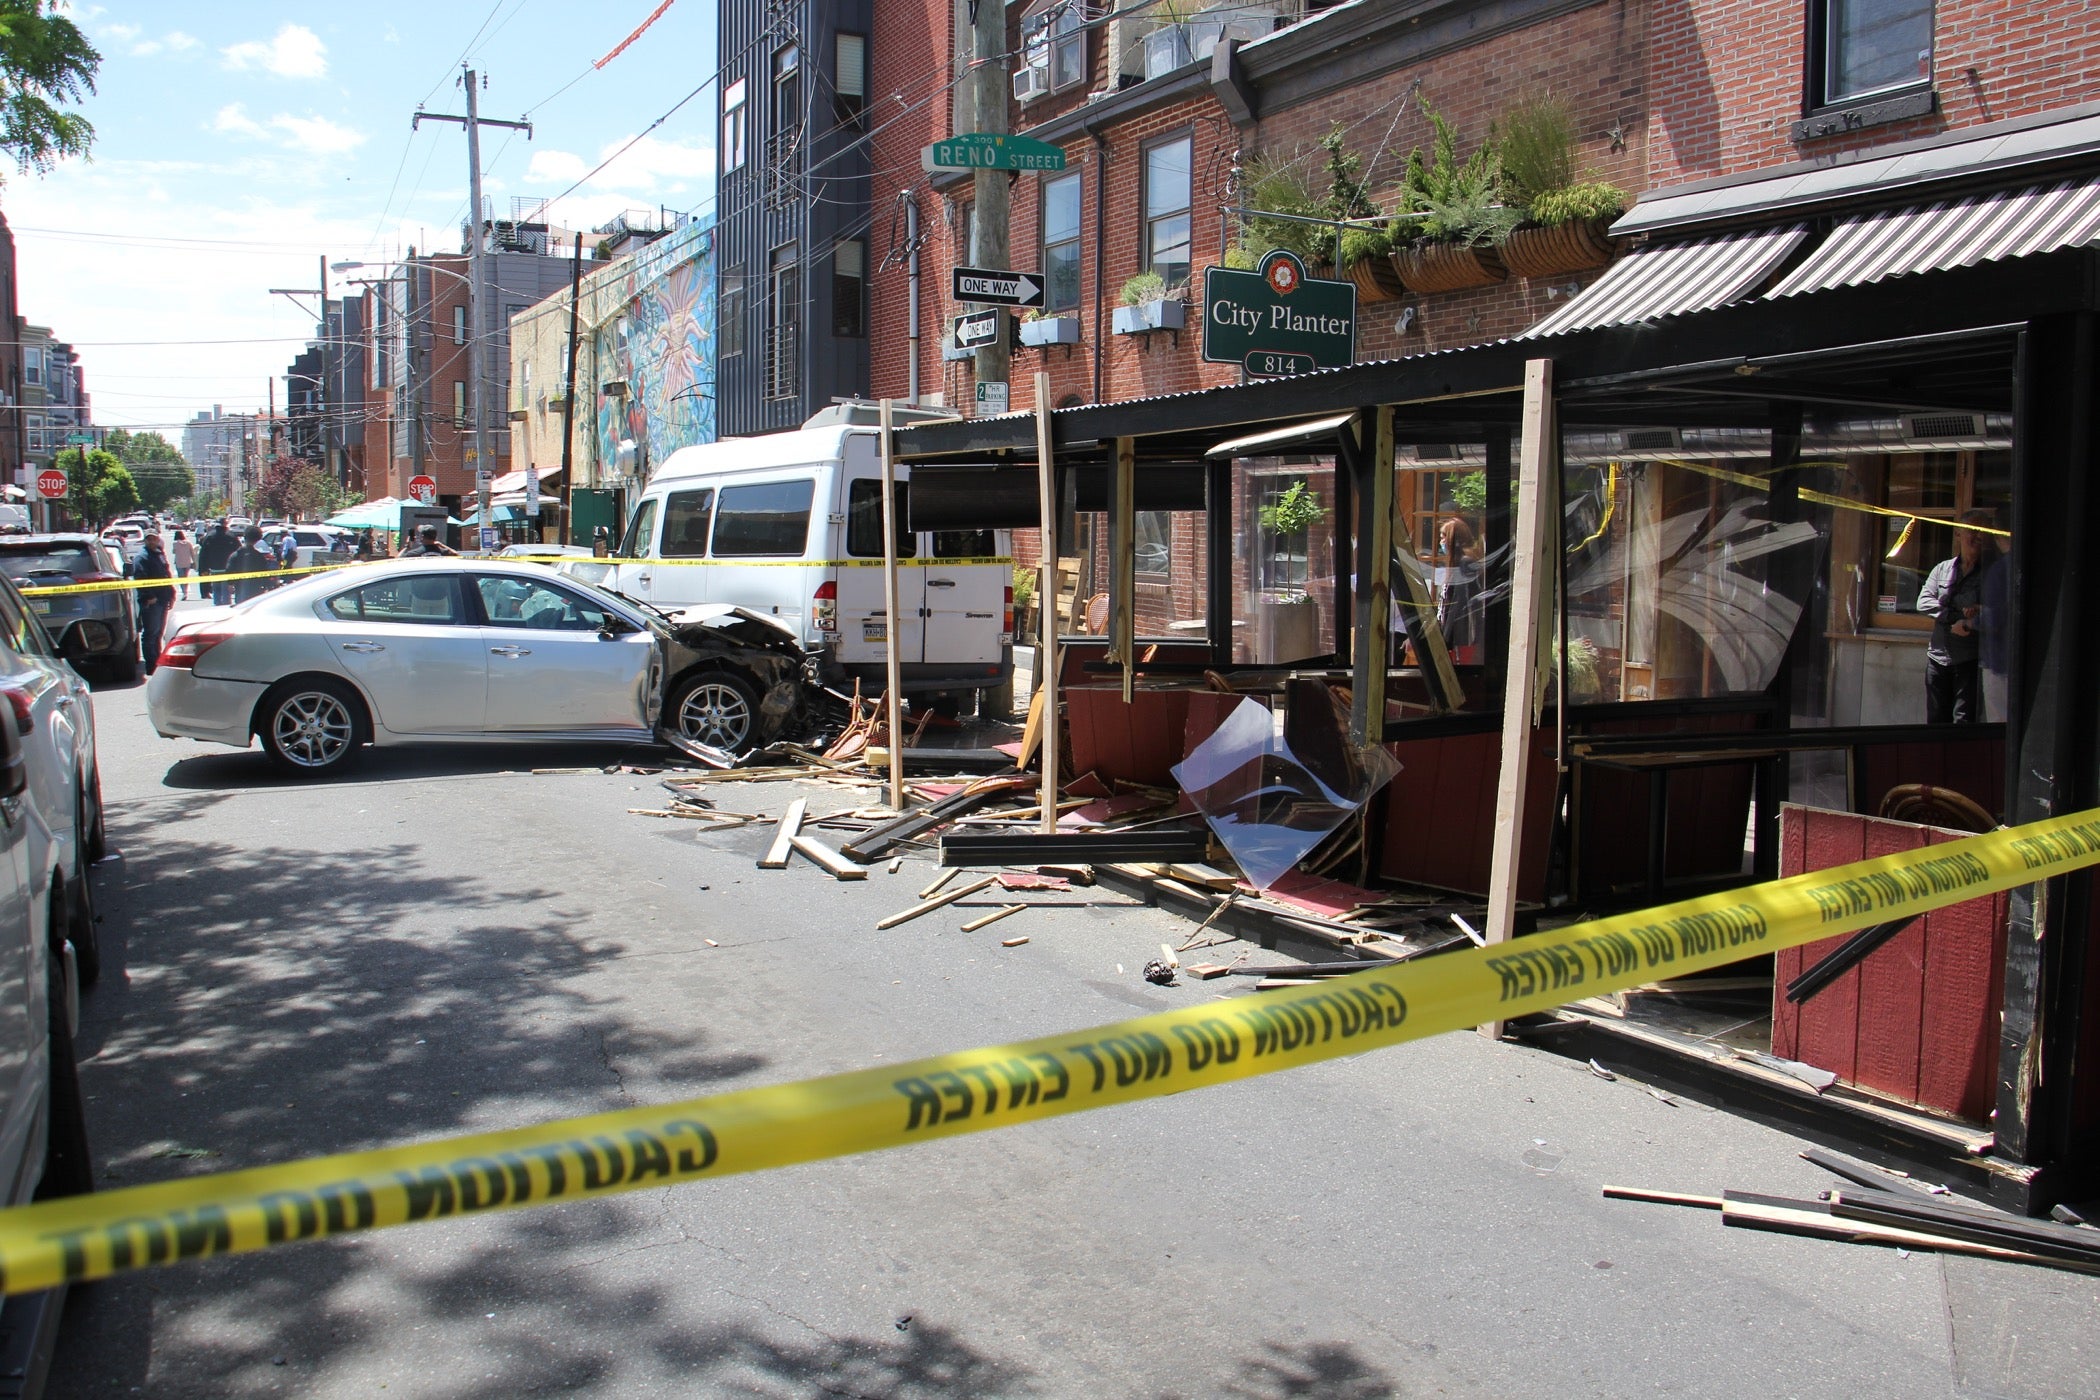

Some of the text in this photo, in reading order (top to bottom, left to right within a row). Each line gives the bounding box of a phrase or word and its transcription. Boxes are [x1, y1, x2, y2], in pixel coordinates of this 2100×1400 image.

[995, 137, 1004, 147] W
[940, 145, 1060, 169] RENO STREET
[964, 278, 1018, 295] ONE WAY
[1212, 299, 1350, 336] City Planter
[967, 319, 993, 338] ONE WAY
[1264, 355, 1296, 374] 814
[978, 385, 985, 399] 2
[39, 478, 66, 490] STOP
